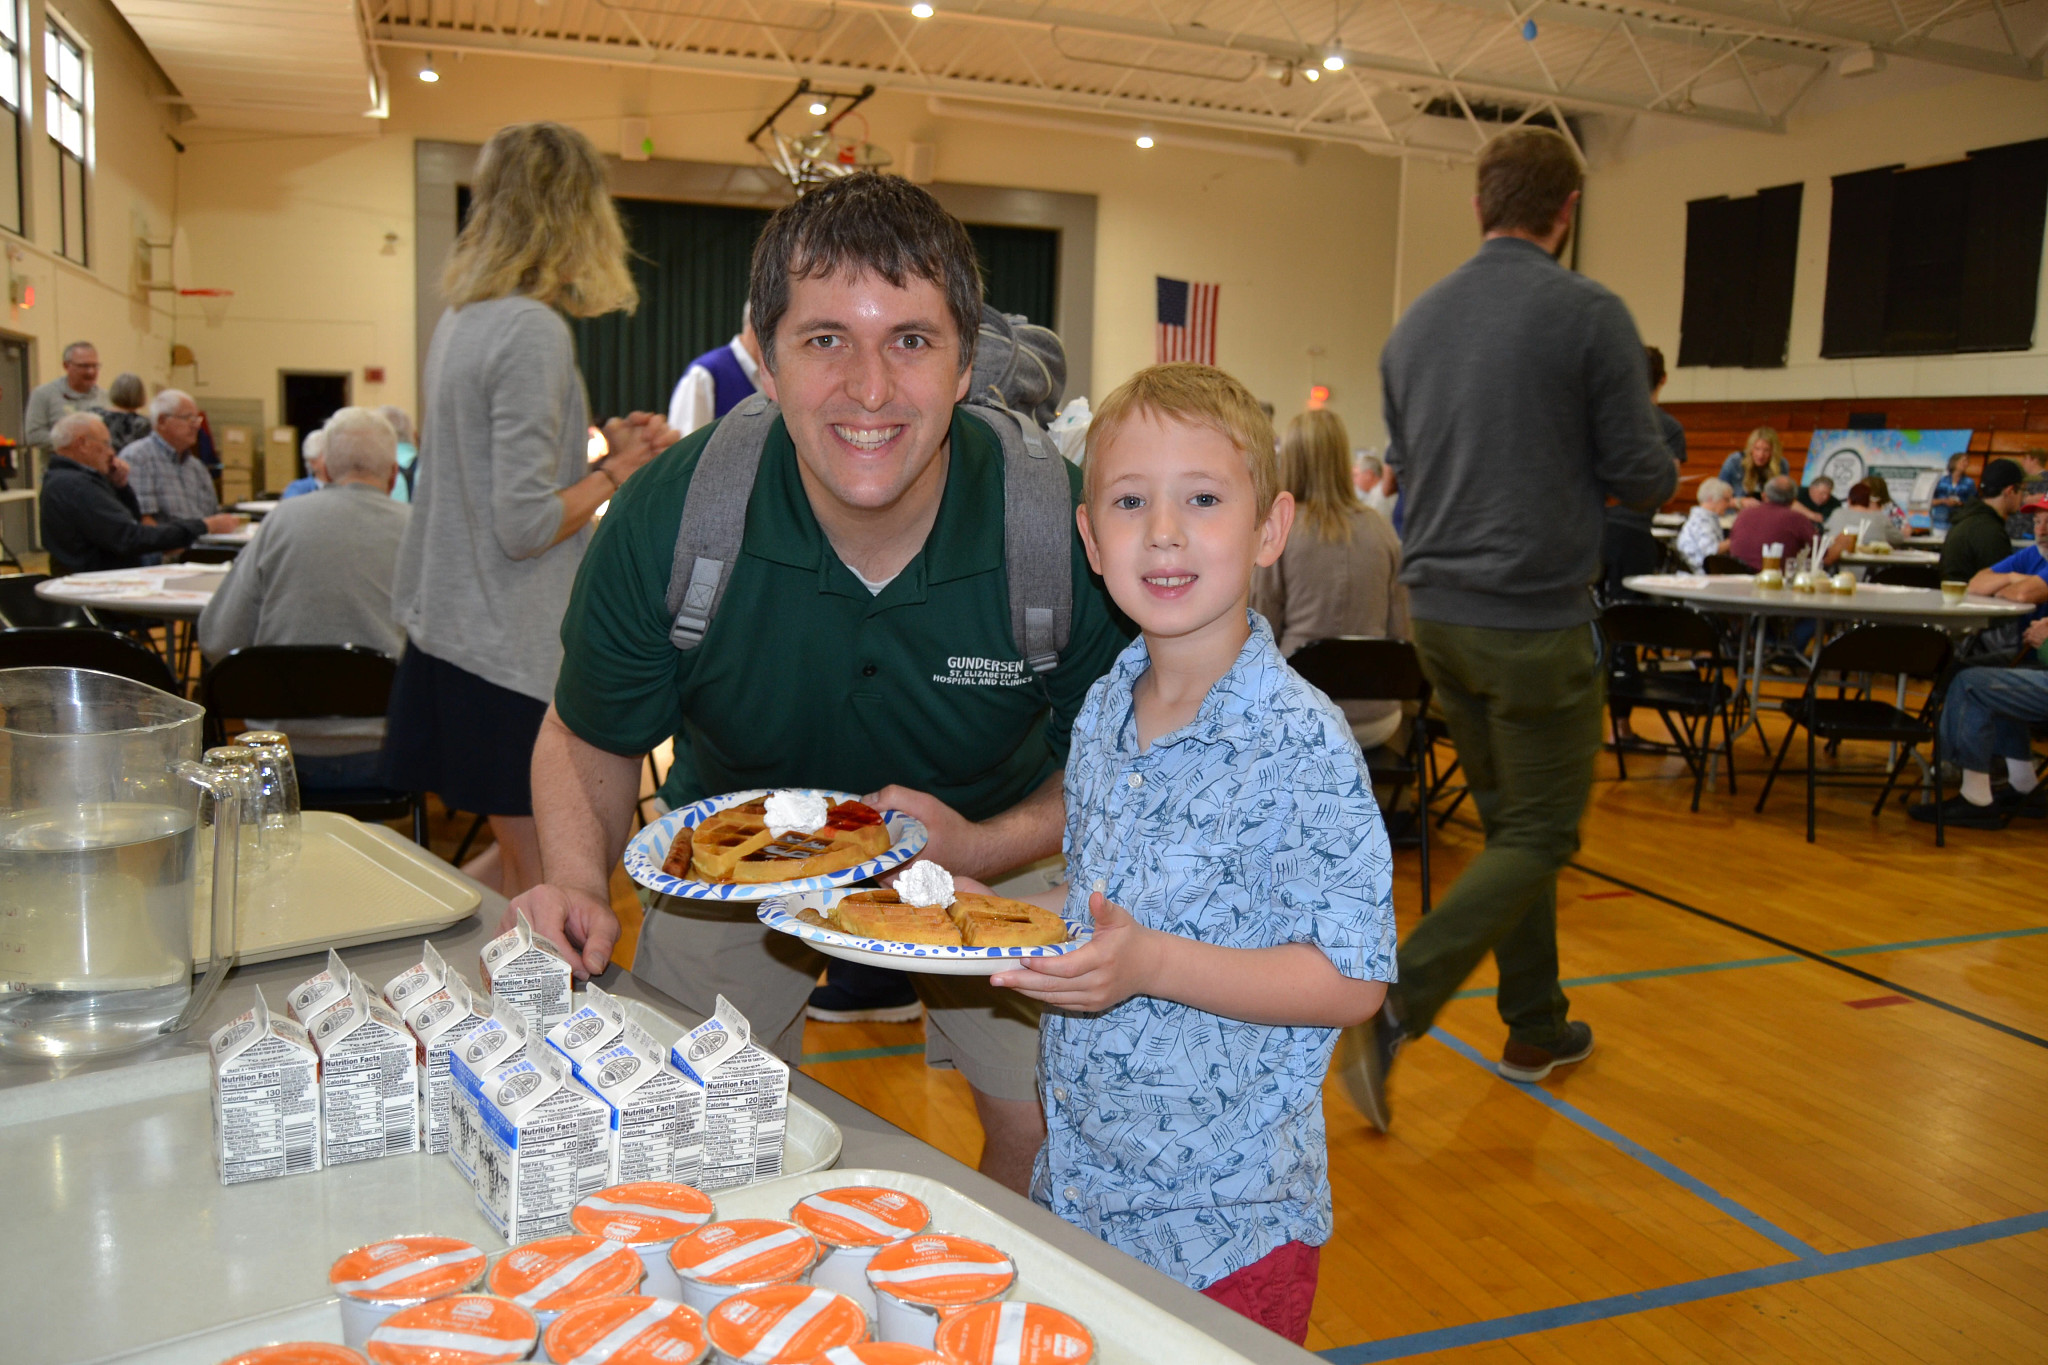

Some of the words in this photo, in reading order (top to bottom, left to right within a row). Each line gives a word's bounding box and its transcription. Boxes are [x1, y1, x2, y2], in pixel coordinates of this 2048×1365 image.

[948, 657, 1024, 672] GUNDERSEN
[964, 670, 1019, 679] ELIZABETH'S
[933, 674, 976, 685] HOSPITAL
[999, 676, 1032, 686] CLINICS
[326, 1058, 358, 1067] Nutrition
[222, 1074, 256, 1083] Nutrition
[623, 1109, 654, 1117] Nutrition
[522, 1127, 554, 1136] Nutrition
[563, 1141, 576, 1149] 120
[852, 1198, 879, 1212] Orange
[880, 1210, 899, 1222] Juice
[905, 1254, 942, 1263] Orange
[429, 1317, 469, 1329] Orange
[471, 1323, 499, 1334] Juice
